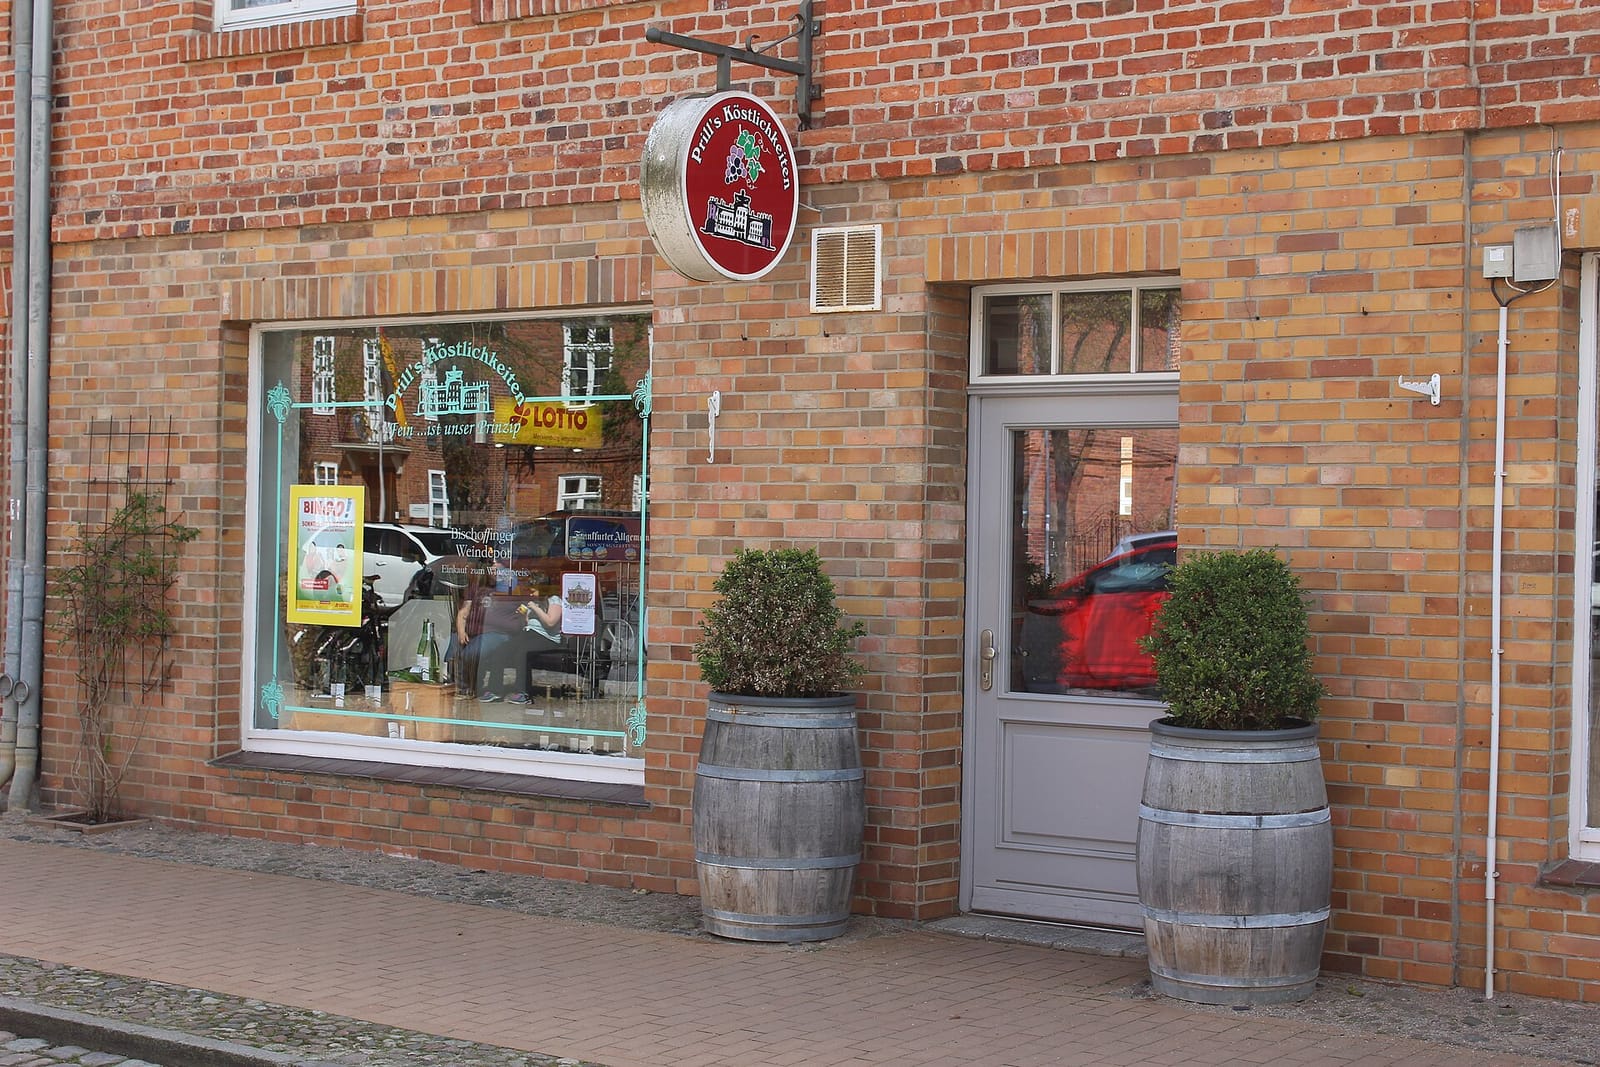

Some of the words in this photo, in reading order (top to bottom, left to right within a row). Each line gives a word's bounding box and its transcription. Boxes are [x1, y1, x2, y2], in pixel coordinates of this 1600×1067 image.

[691, 117, 722, 164] Prill's
[722, 104, 790, 190] Köstlichkeiten
[385, 361, 424, 412] Prill's
[425, 340, 525, 407] Köstlichkeiten
[444, 423, 475, 435] unser
[477, 418, 521, 440] Prinzip
[533, 406, 588, 430] LOTTO
[451, 527, 516, 544] Bischoffinger
[455, 544, 512, 563] Weindepot
[441, 564, 469, 574] Einkauf
[470, 567, 485, 575] zum
